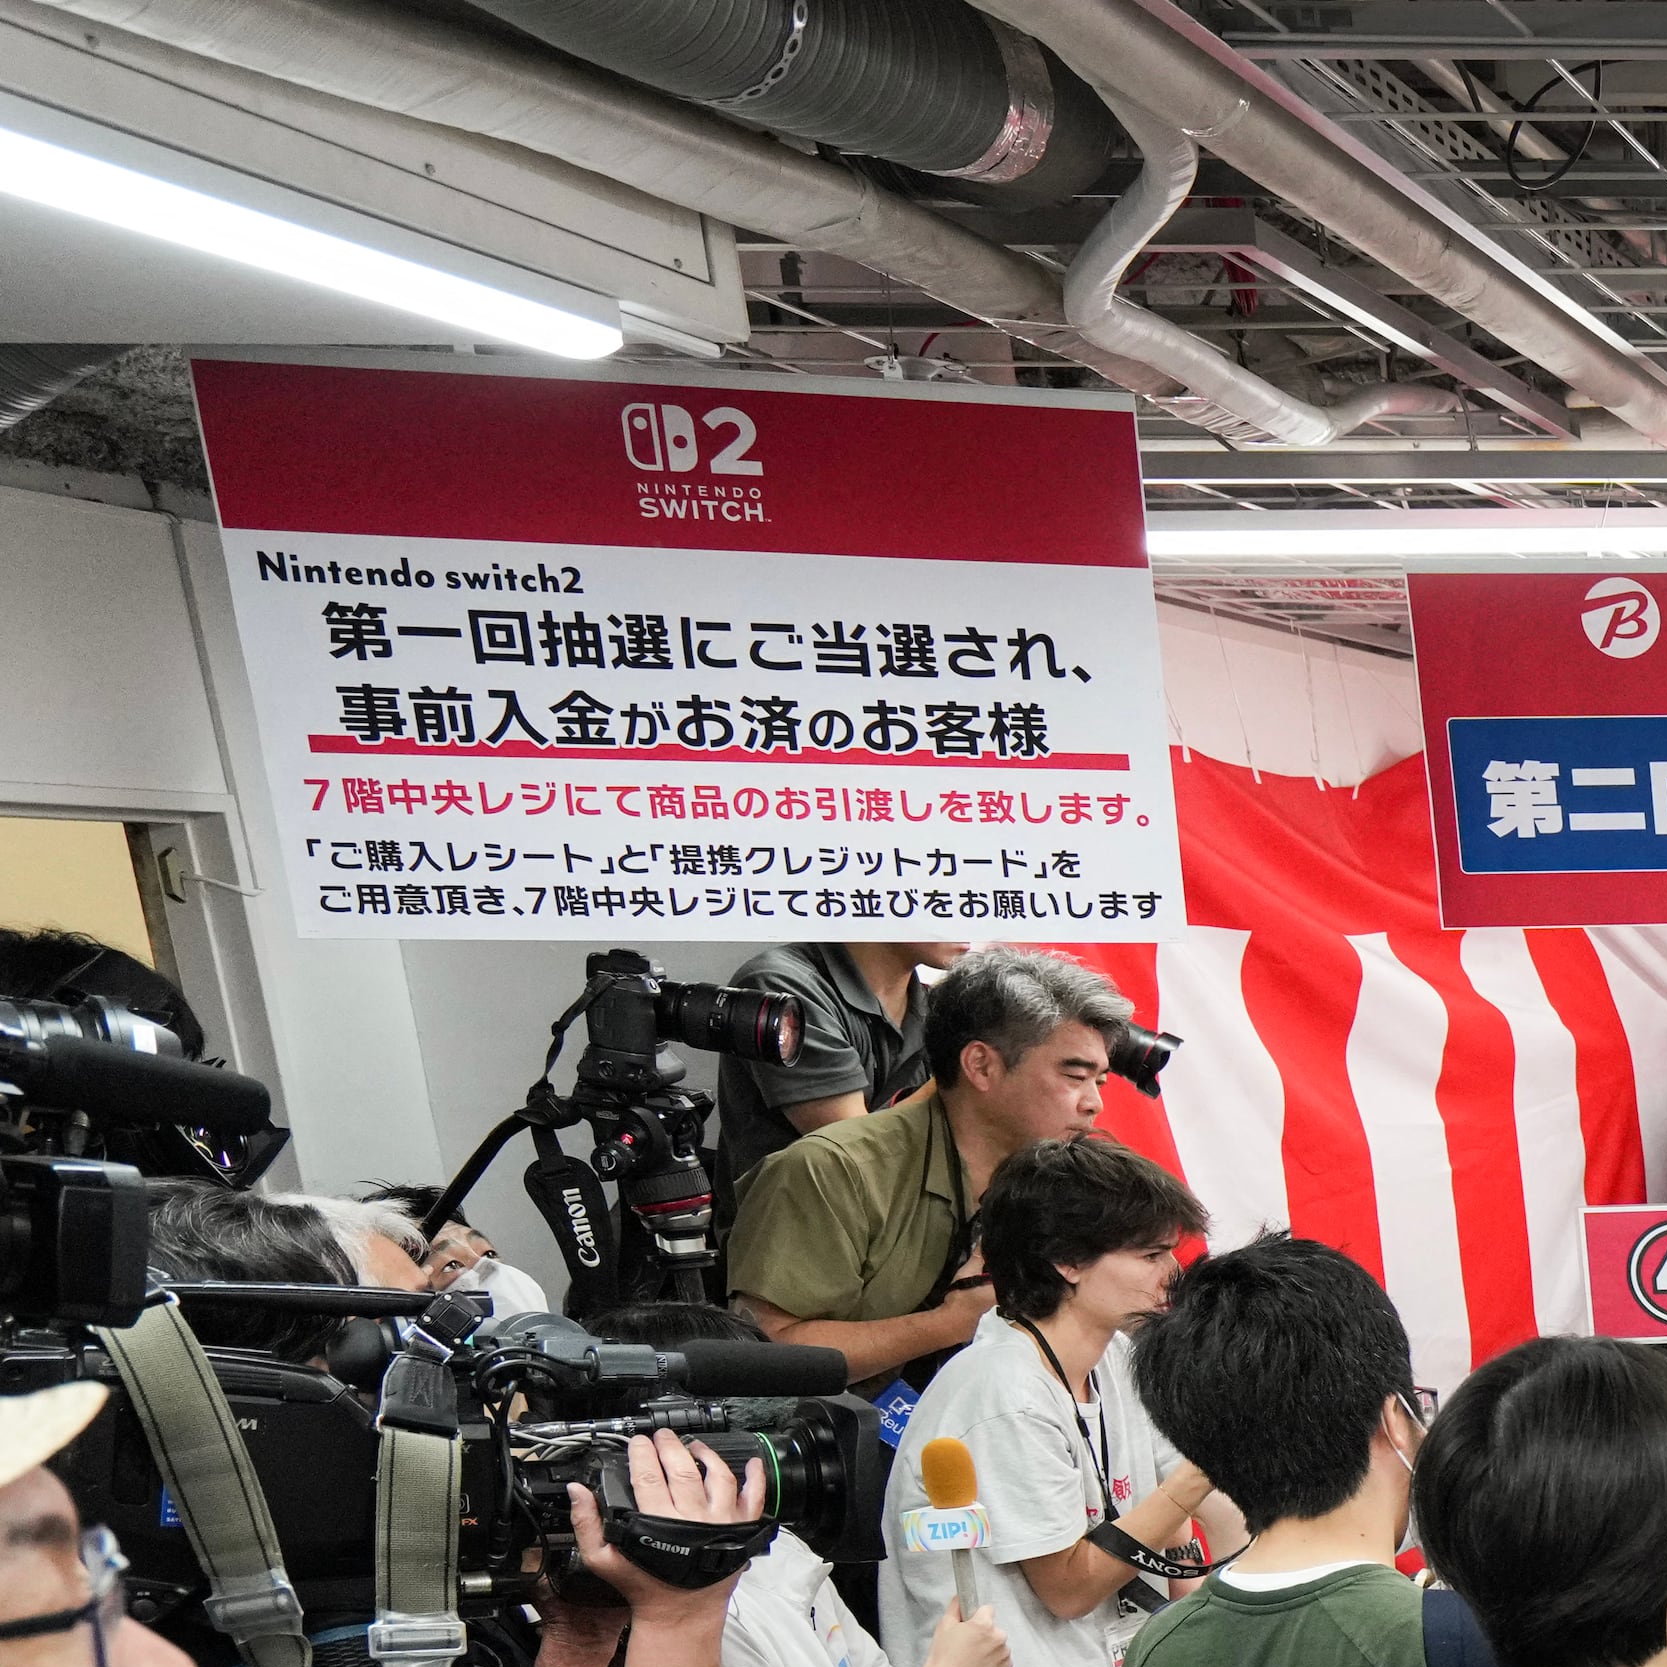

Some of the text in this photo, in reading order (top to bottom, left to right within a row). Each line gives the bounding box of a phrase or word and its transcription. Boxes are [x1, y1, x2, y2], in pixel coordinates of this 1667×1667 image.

[636, 482, 762, 499] NINTENDO
[638, 498, 766, 523] SWITCH
[257, 549, 585, 596] Nintendo switch2
[319, 599, 1096, 686] 第一回抽選にご当選され、
[336, 683, 1051, 760] 事前入金がお済のお客様
[305, 837, 1081, 880] 「ご購入レシート」と「提携クレジットカード」を
[318, 880, 1164, 922] ご用意頂き、7階中央レジにてお並びをお願いします
[561, 1187, 601, 1269] Canon
[638, 1535, 691, 1557] Canon
[926, 1520, 969, 1541] ZIP!
[1130, 1549, 1200, 1579] SONY
